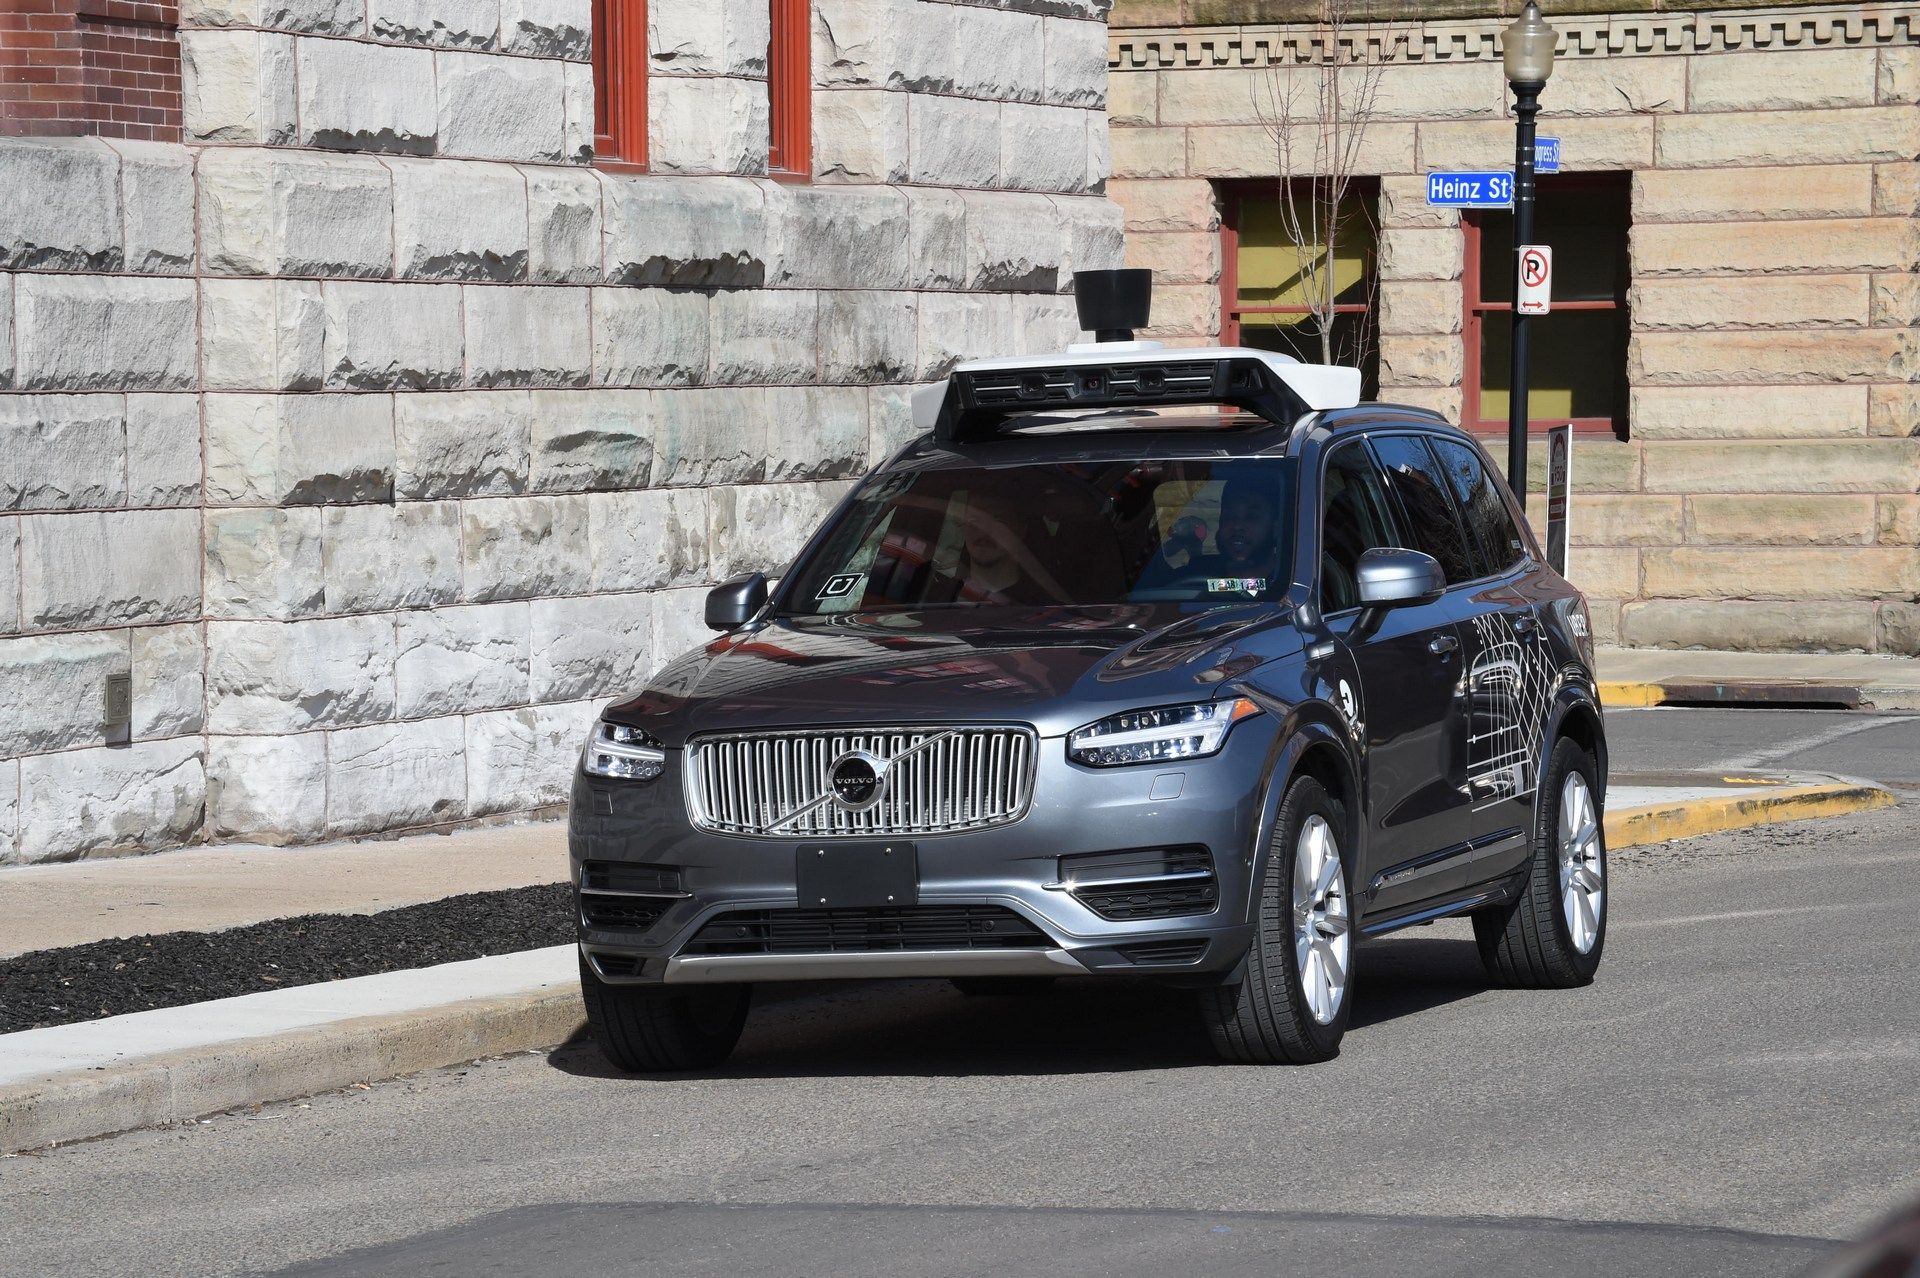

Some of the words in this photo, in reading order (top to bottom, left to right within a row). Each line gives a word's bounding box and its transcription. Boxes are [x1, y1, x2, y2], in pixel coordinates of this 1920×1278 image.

[1535, 146, 1553, 168] ogress
[1553, 142, 1559, 163] St
[1430, 177, 1481, 199] Heinz
[1488, 177, 1509, 199] St
[1526, 259, 1540, 280] P
[1566, 614, 1588, 637] UBER
[835, 777, 874, 785] VOLVO
